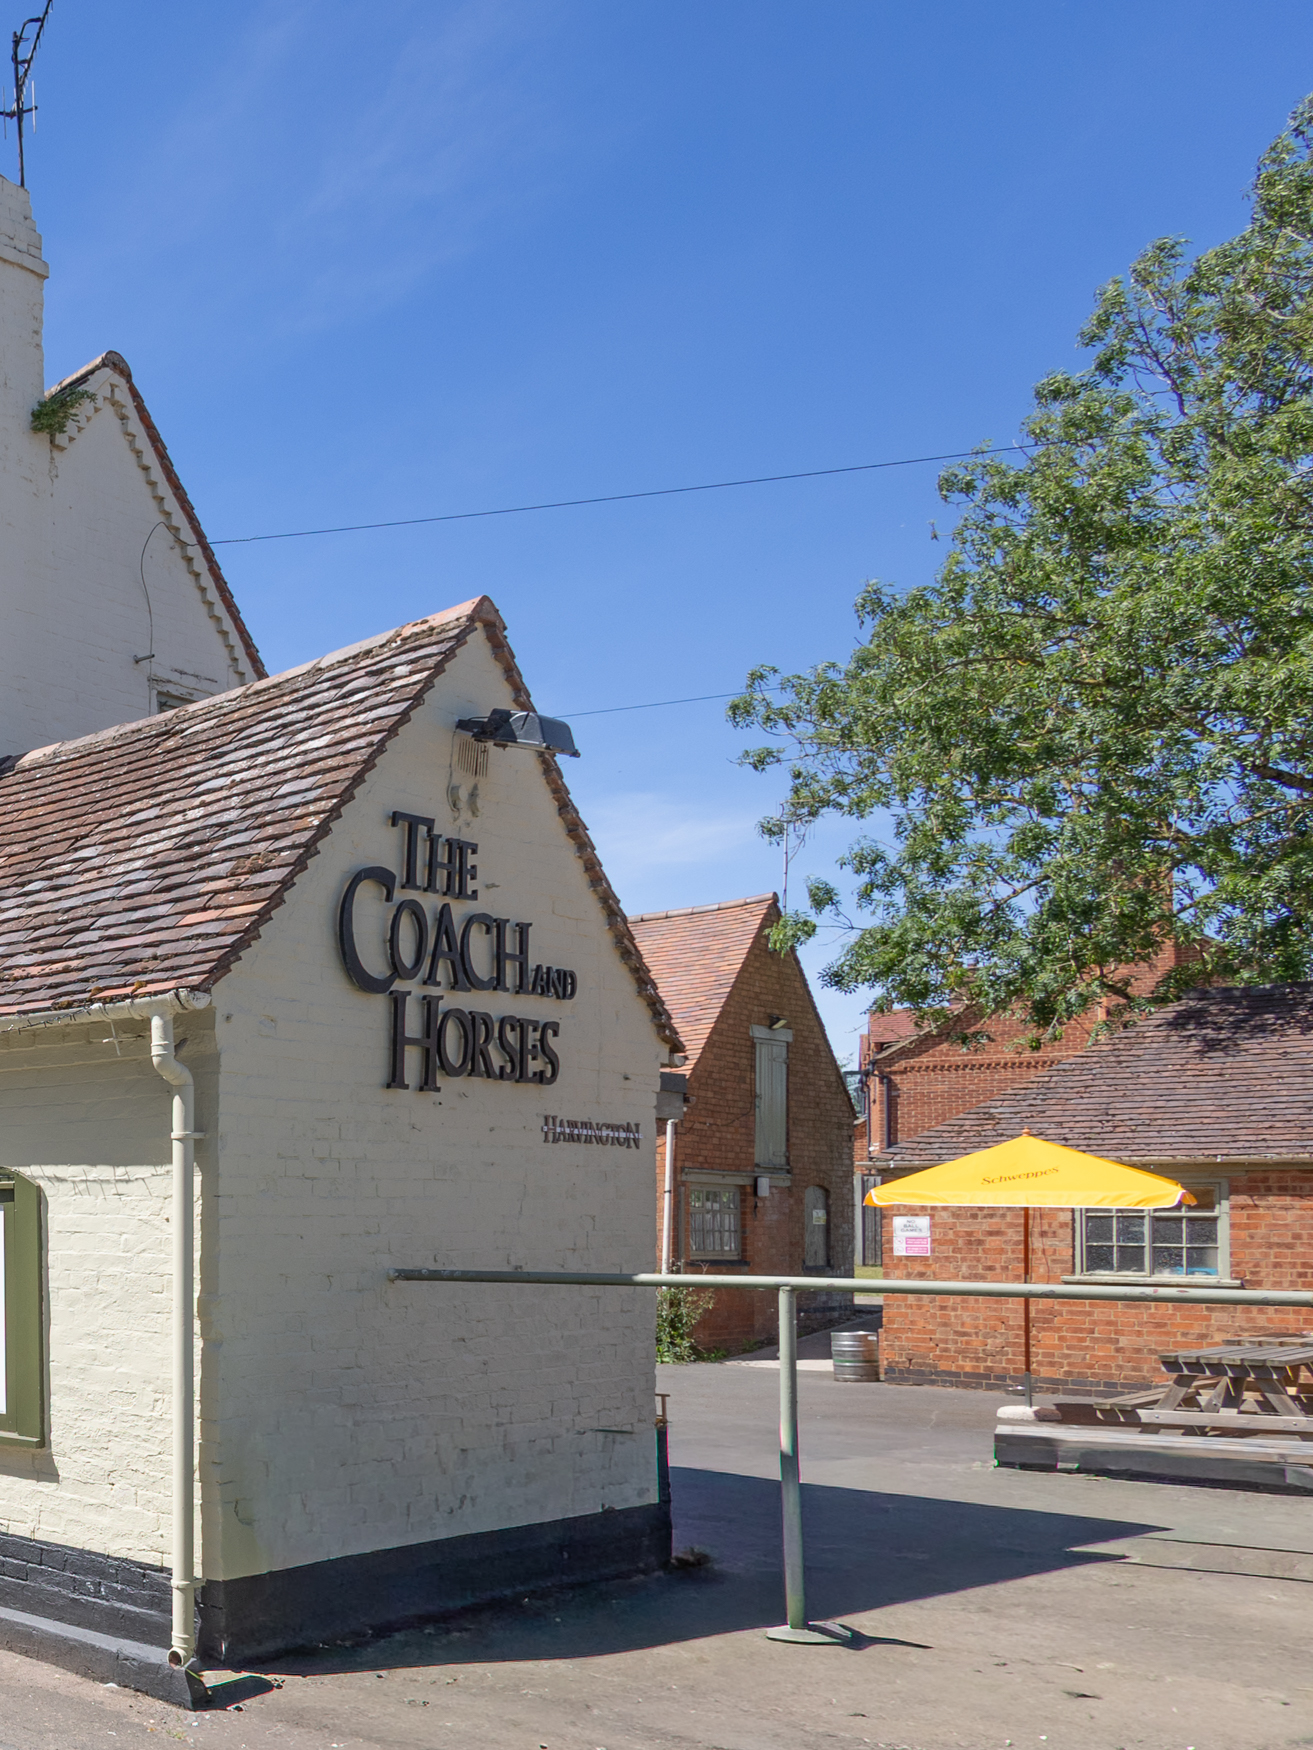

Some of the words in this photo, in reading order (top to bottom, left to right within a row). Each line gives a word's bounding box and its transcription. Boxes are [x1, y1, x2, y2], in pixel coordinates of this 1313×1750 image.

[391, 811, 479, 900] THE
[340, 866, 533, 995] COACH
[532, 964, 577, 1000] AND
[386, 990, 560, 1092] HORSES
[542, 1114, 641, 1149] HARVINGTON
[981, 1165, 1060, 1185] Schweppes
